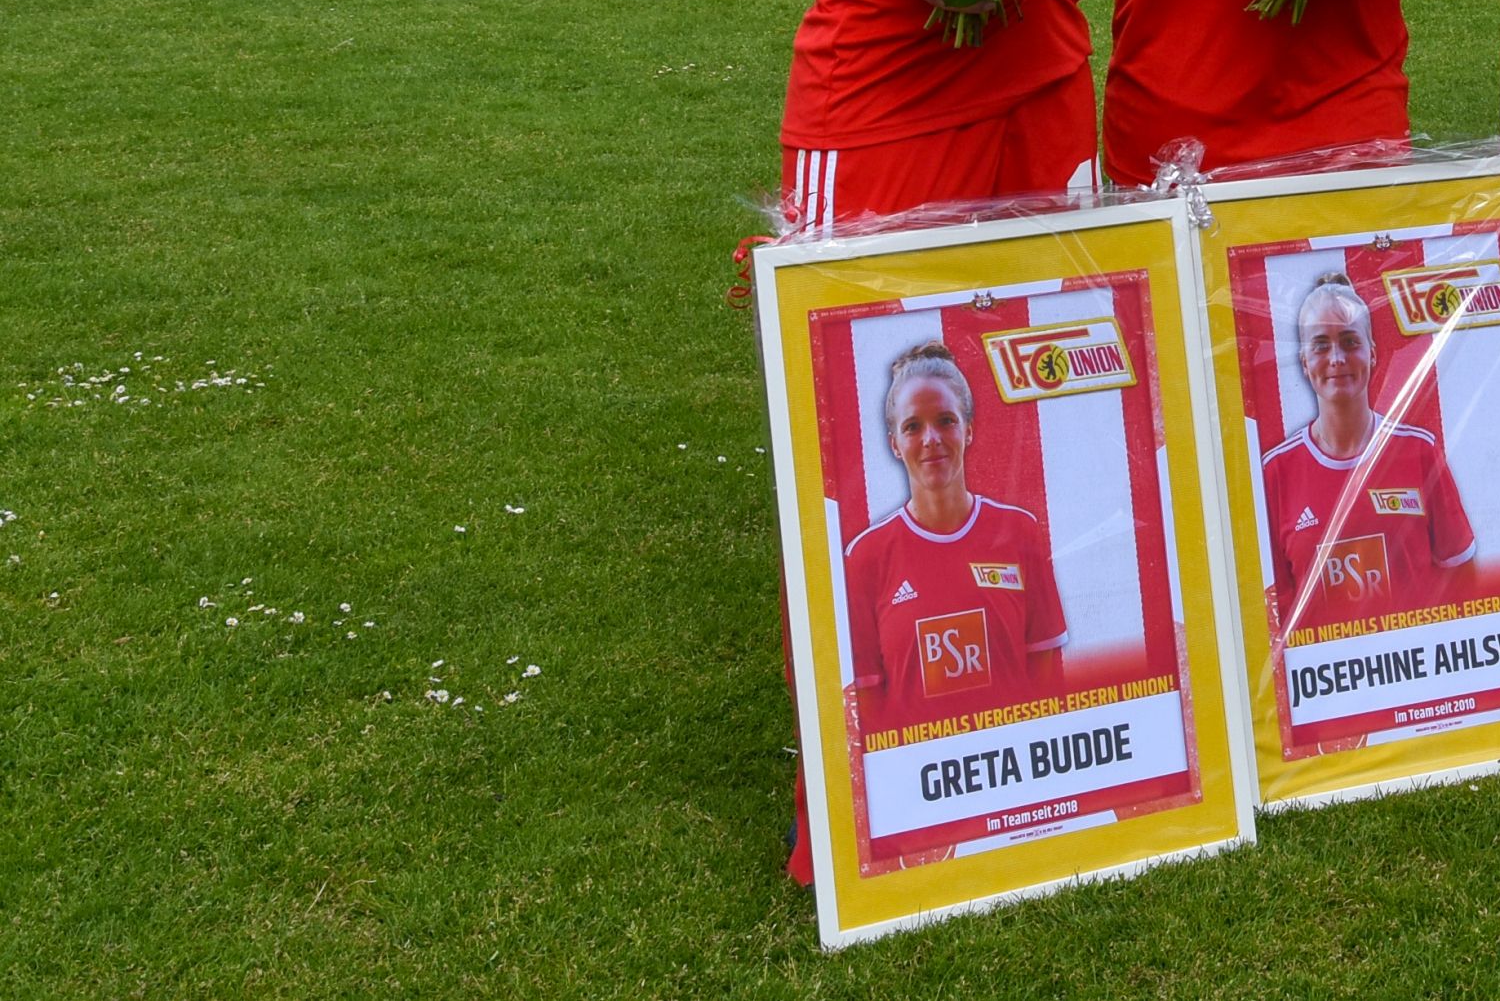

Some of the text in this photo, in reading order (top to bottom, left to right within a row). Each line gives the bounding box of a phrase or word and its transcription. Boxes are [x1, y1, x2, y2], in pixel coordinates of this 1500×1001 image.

[1067, 344, 1124, 377] UNION
[1295, 518, 1319, 531] adidas
[892, 591, 918, 605] adidas
[1326, 553, 1385, 601] BSR
[1287, 629, 1315, 647] UND
[1318, 618, 1378, 642] NIEMALS
[1381, 605, 1462, 632] VERGESSEN:
[924, 628, 984, 678] BSR
[1292, 647, 1427, 708] JOSEPHINE
[866, 674, 1175, 752] UND NIEMALS VERGESSEN: EISERN UNION!
[1408, 706, 1434, 722] Team
[1434, 702, 1452, 717] seit
[1453, 697, 1476, 713] 2010
[920, 723, 1133, 801] GRETA BUDDE
[986, 801, 1078, 832] im Team seit 2018
